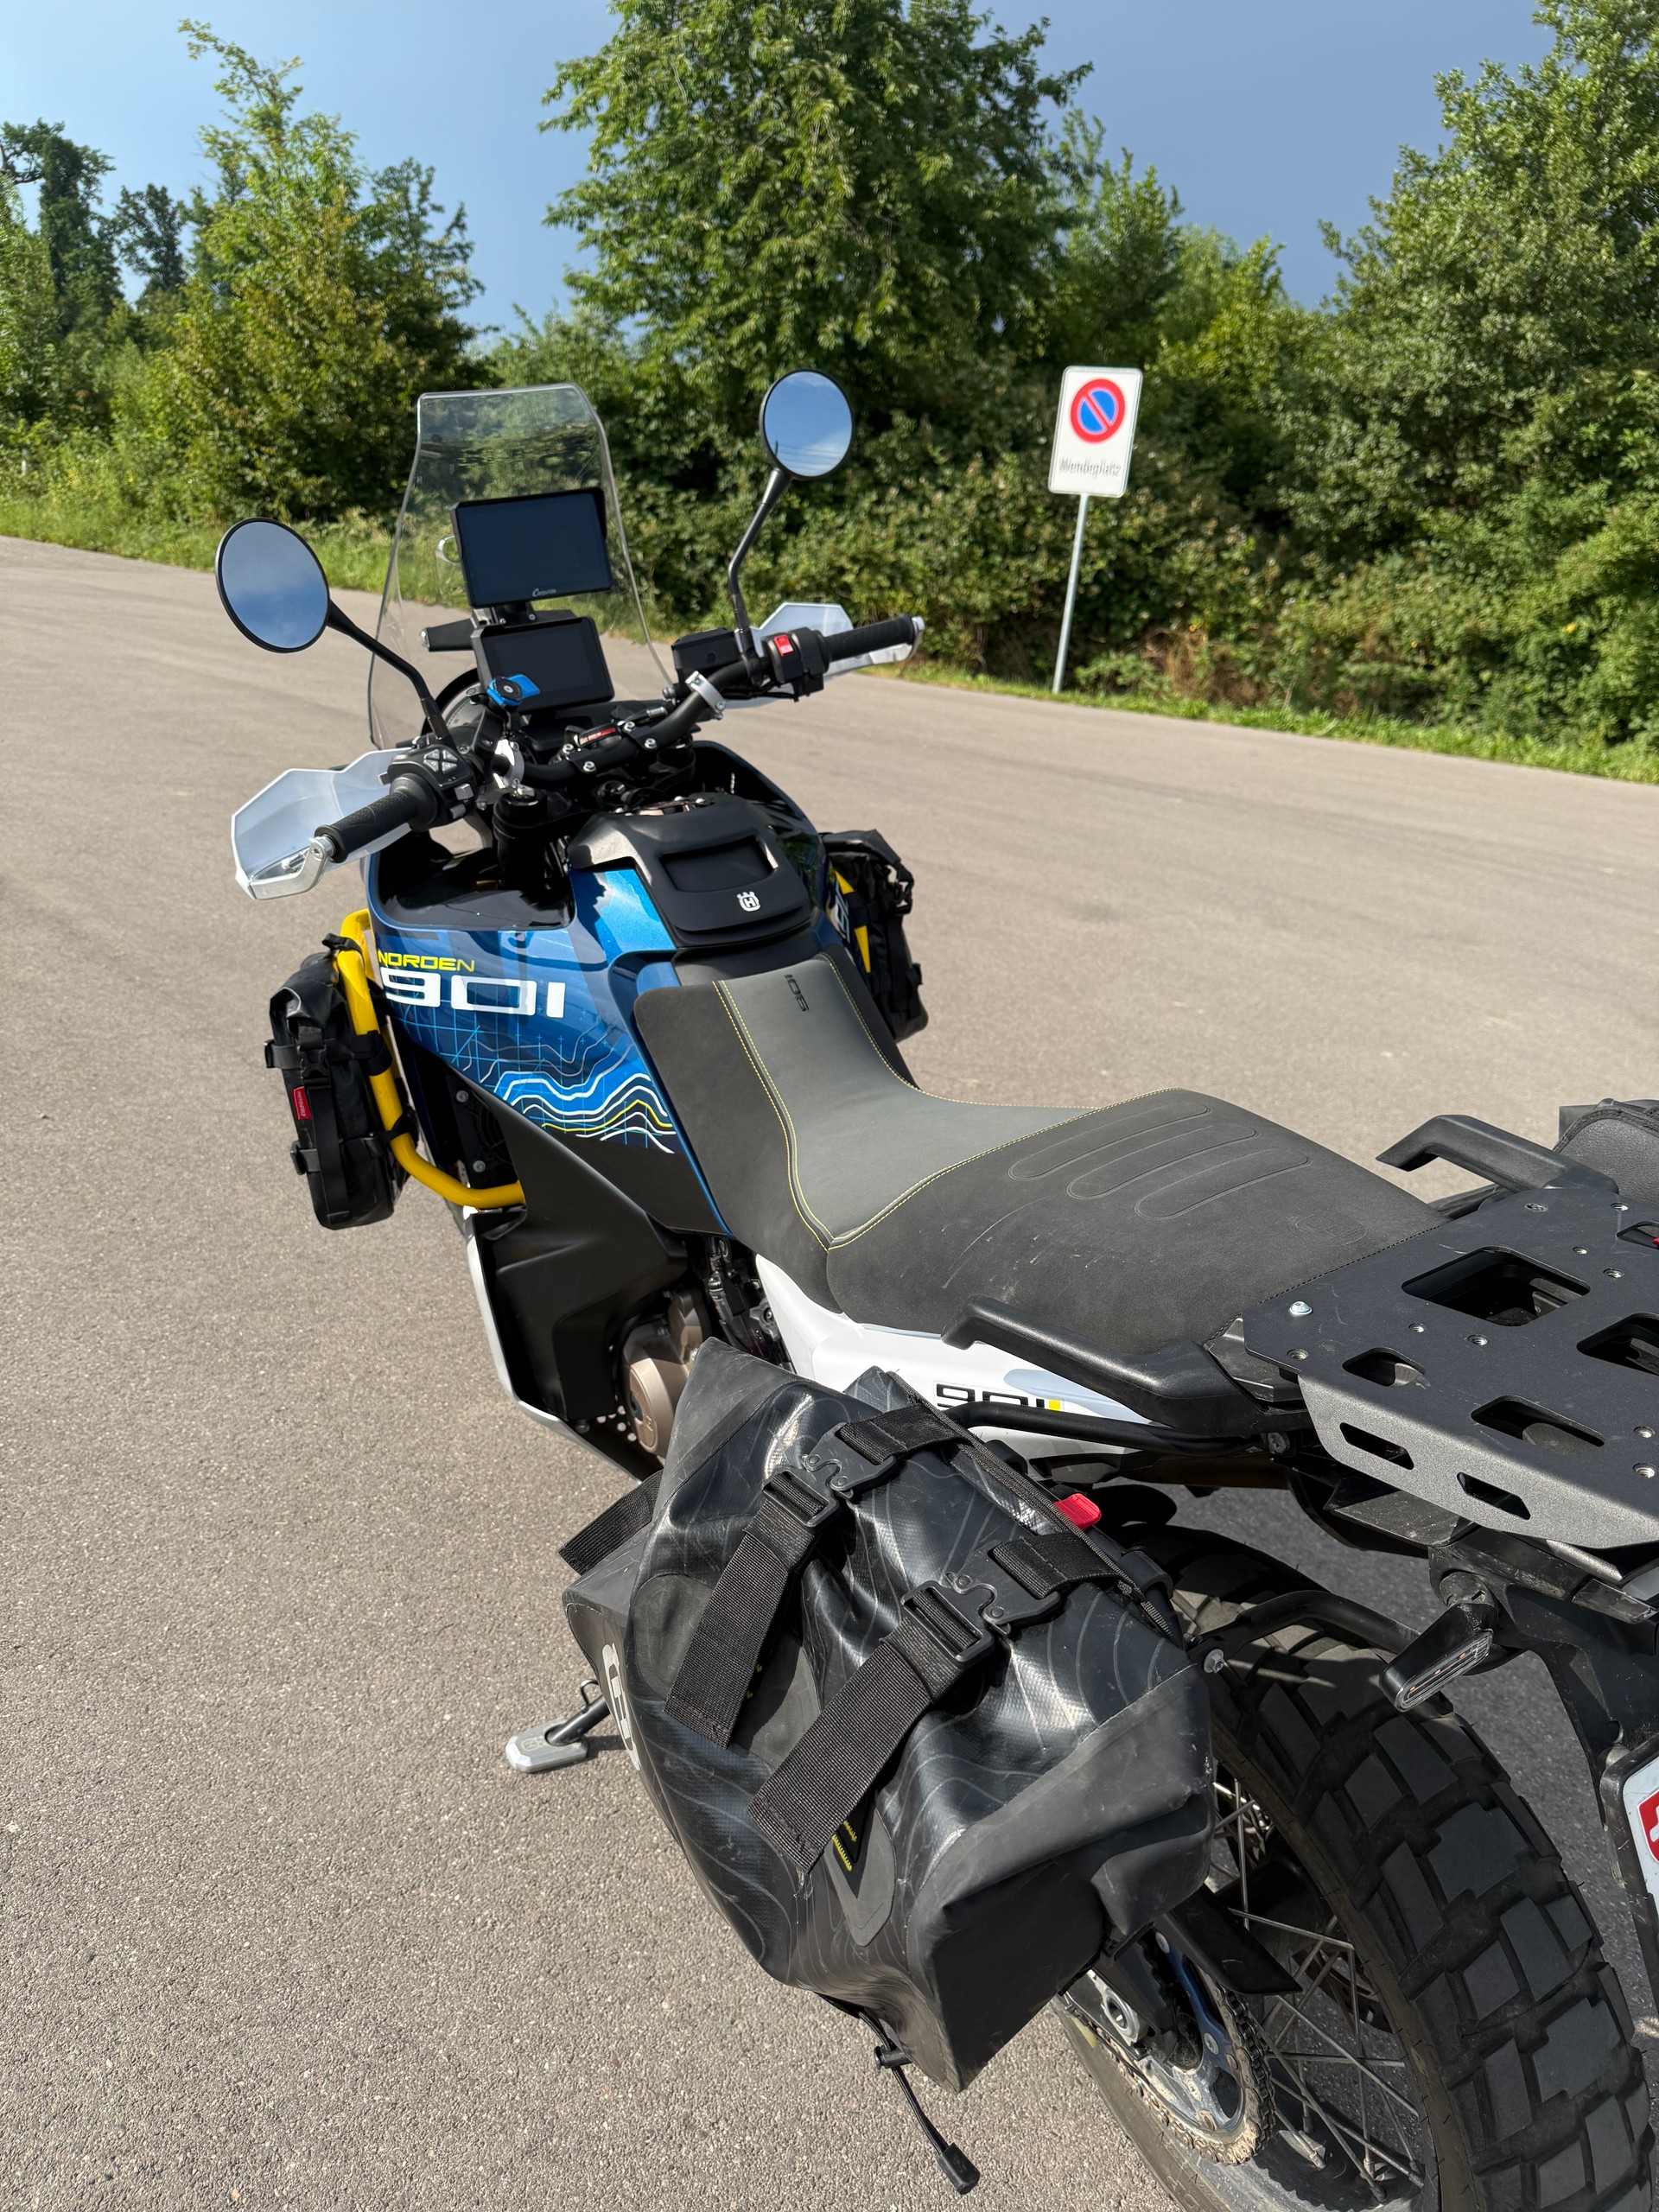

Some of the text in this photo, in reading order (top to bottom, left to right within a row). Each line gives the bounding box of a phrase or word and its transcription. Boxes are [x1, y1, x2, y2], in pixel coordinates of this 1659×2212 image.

[1058, 457, 1122, 480] Wendeplatz
[378, 950, 475, 973] NORDEN
[380, 967, 566, 1019] 901
